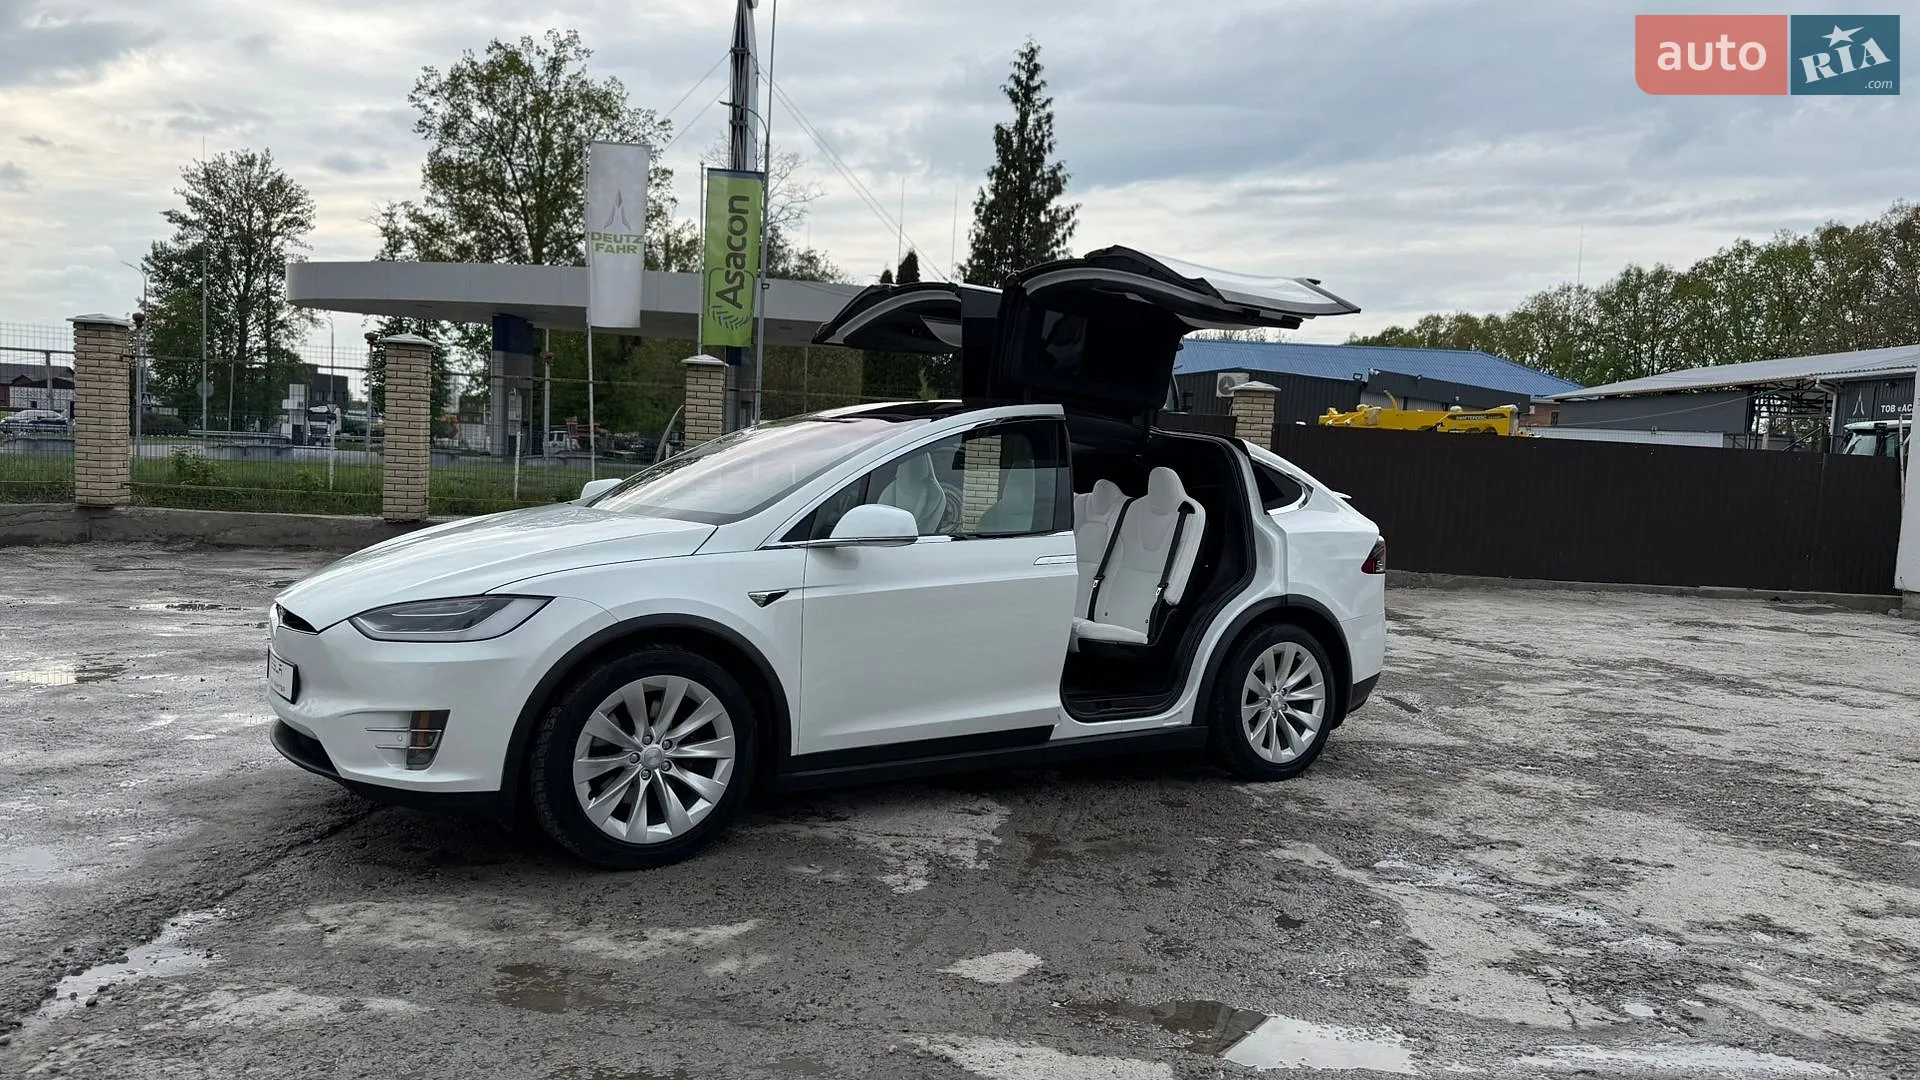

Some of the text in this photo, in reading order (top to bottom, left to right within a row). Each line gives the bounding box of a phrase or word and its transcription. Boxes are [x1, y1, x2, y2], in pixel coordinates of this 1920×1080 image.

[591, 232, 644, 244] DEUTZ
[595, 243, 638, 254] FAHR
[715, 195, 750, 310] Asacon
[1880, 404, 1896, 413] ТОВ
